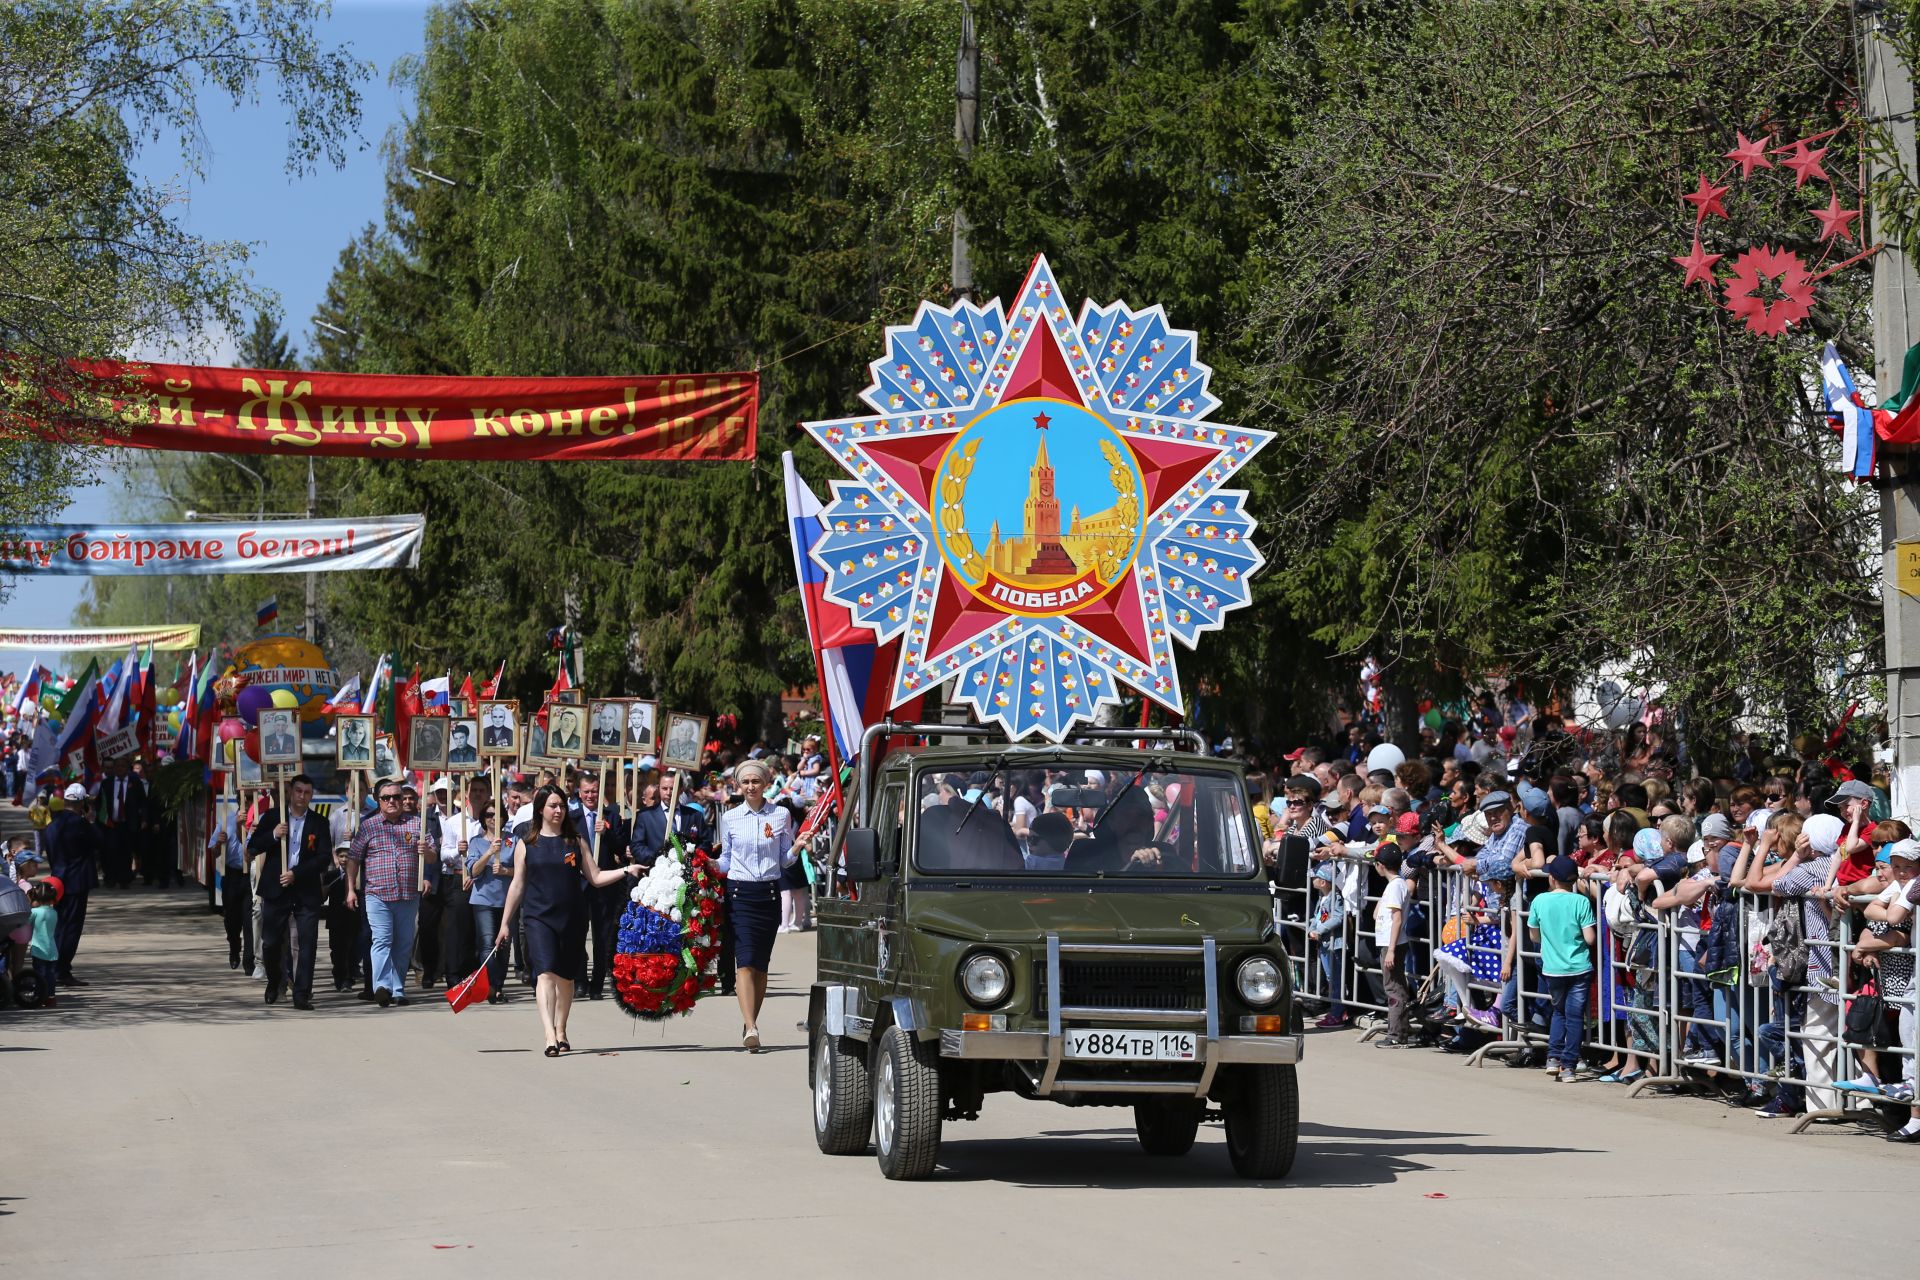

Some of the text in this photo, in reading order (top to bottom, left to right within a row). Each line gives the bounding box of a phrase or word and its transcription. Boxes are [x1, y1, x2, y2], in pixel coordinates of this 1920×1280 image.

[470, 387, 638, 437] көне!
[67, 531, 224, 566] бәйрәме
[237, 529, 356, 559] белән!
[991, 581, 1094, 608] ПОБЕДА
[283, 668, 311, 683] МИР!
[315, 670, 331, 684] НЕТ
[1074, 1033, 1190, 1056] У884ТВ 116
